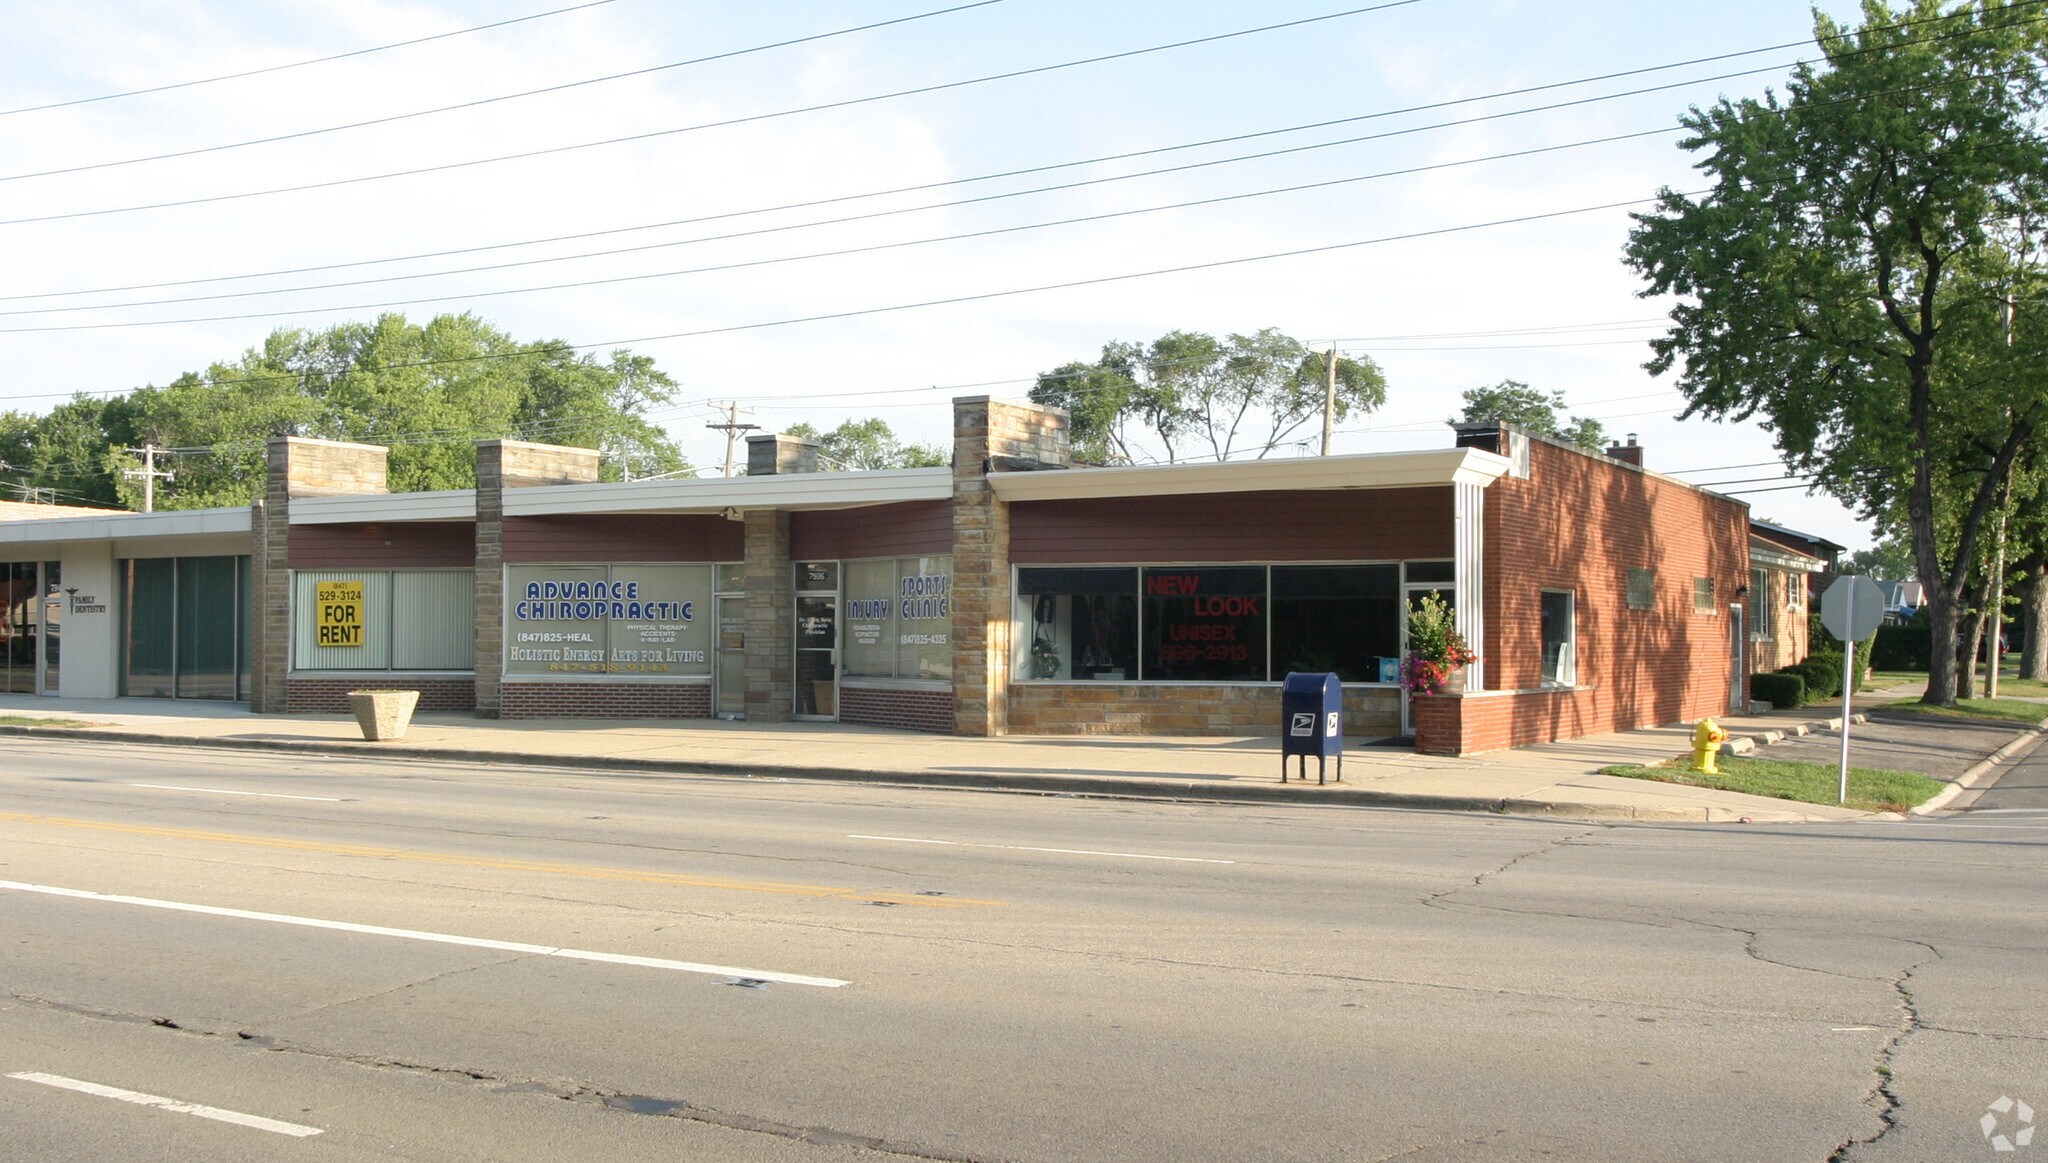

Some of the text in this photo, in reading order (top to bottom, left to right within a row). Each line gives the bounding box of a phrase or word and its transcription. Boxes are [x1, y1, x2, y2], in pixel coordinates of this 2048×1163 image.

[526, 580, 638, 600] ADVANCE
[901, 575, 947, 598] SPORTS
[1147, 575, 1200, 595] NEW
[75, 596, 95, 604] FAMILY
[75, 605, 106, 613] DENTISTRY
[901, 597, 947, 620] CLINIC
[1194, 596, 1259, 616] LOOK
[325, 605, 355, 623] FOR
[515, 601, 694, 621] CHIROPRACTIC
[847, 599, 888, 621] INJURY
[320, 625, 361, 643] RENT
[517, 633, 594, 642] (847)825-HEAL
[1170, 625, 1235, 640] UNISEX
[510, 646, 704, 663] HOLISTIC ENERGY ARTS FOR LIVING
